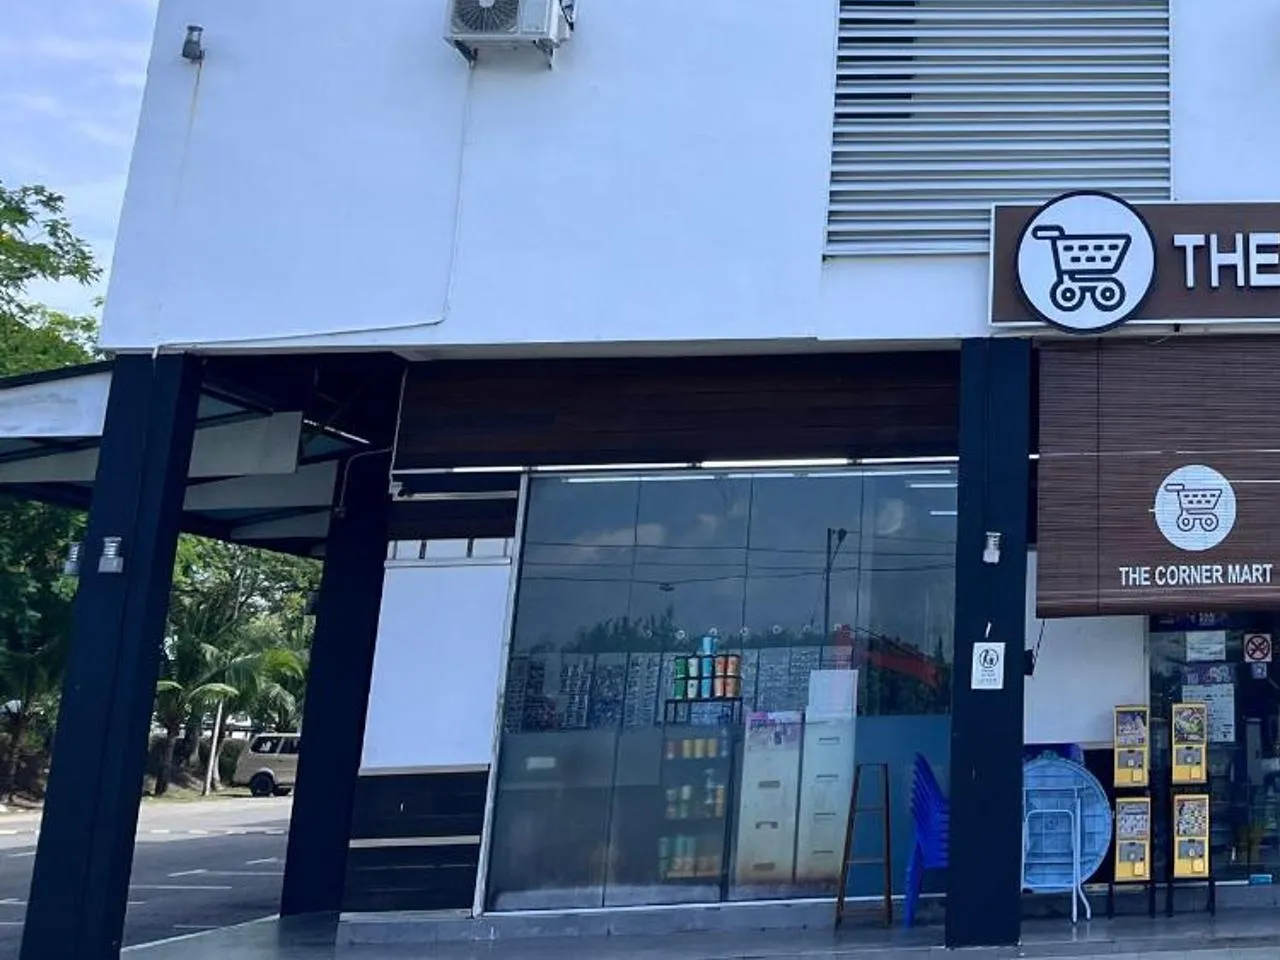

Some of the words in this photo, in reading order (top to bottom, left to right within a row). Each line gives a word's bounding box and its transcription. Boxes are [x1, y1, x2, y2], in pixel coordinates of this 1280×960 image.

[1118, 566, 1151, 587] THE
[1154, 565, 1224, 586] CORNER
[1227, 563, 1273, 584] MART
